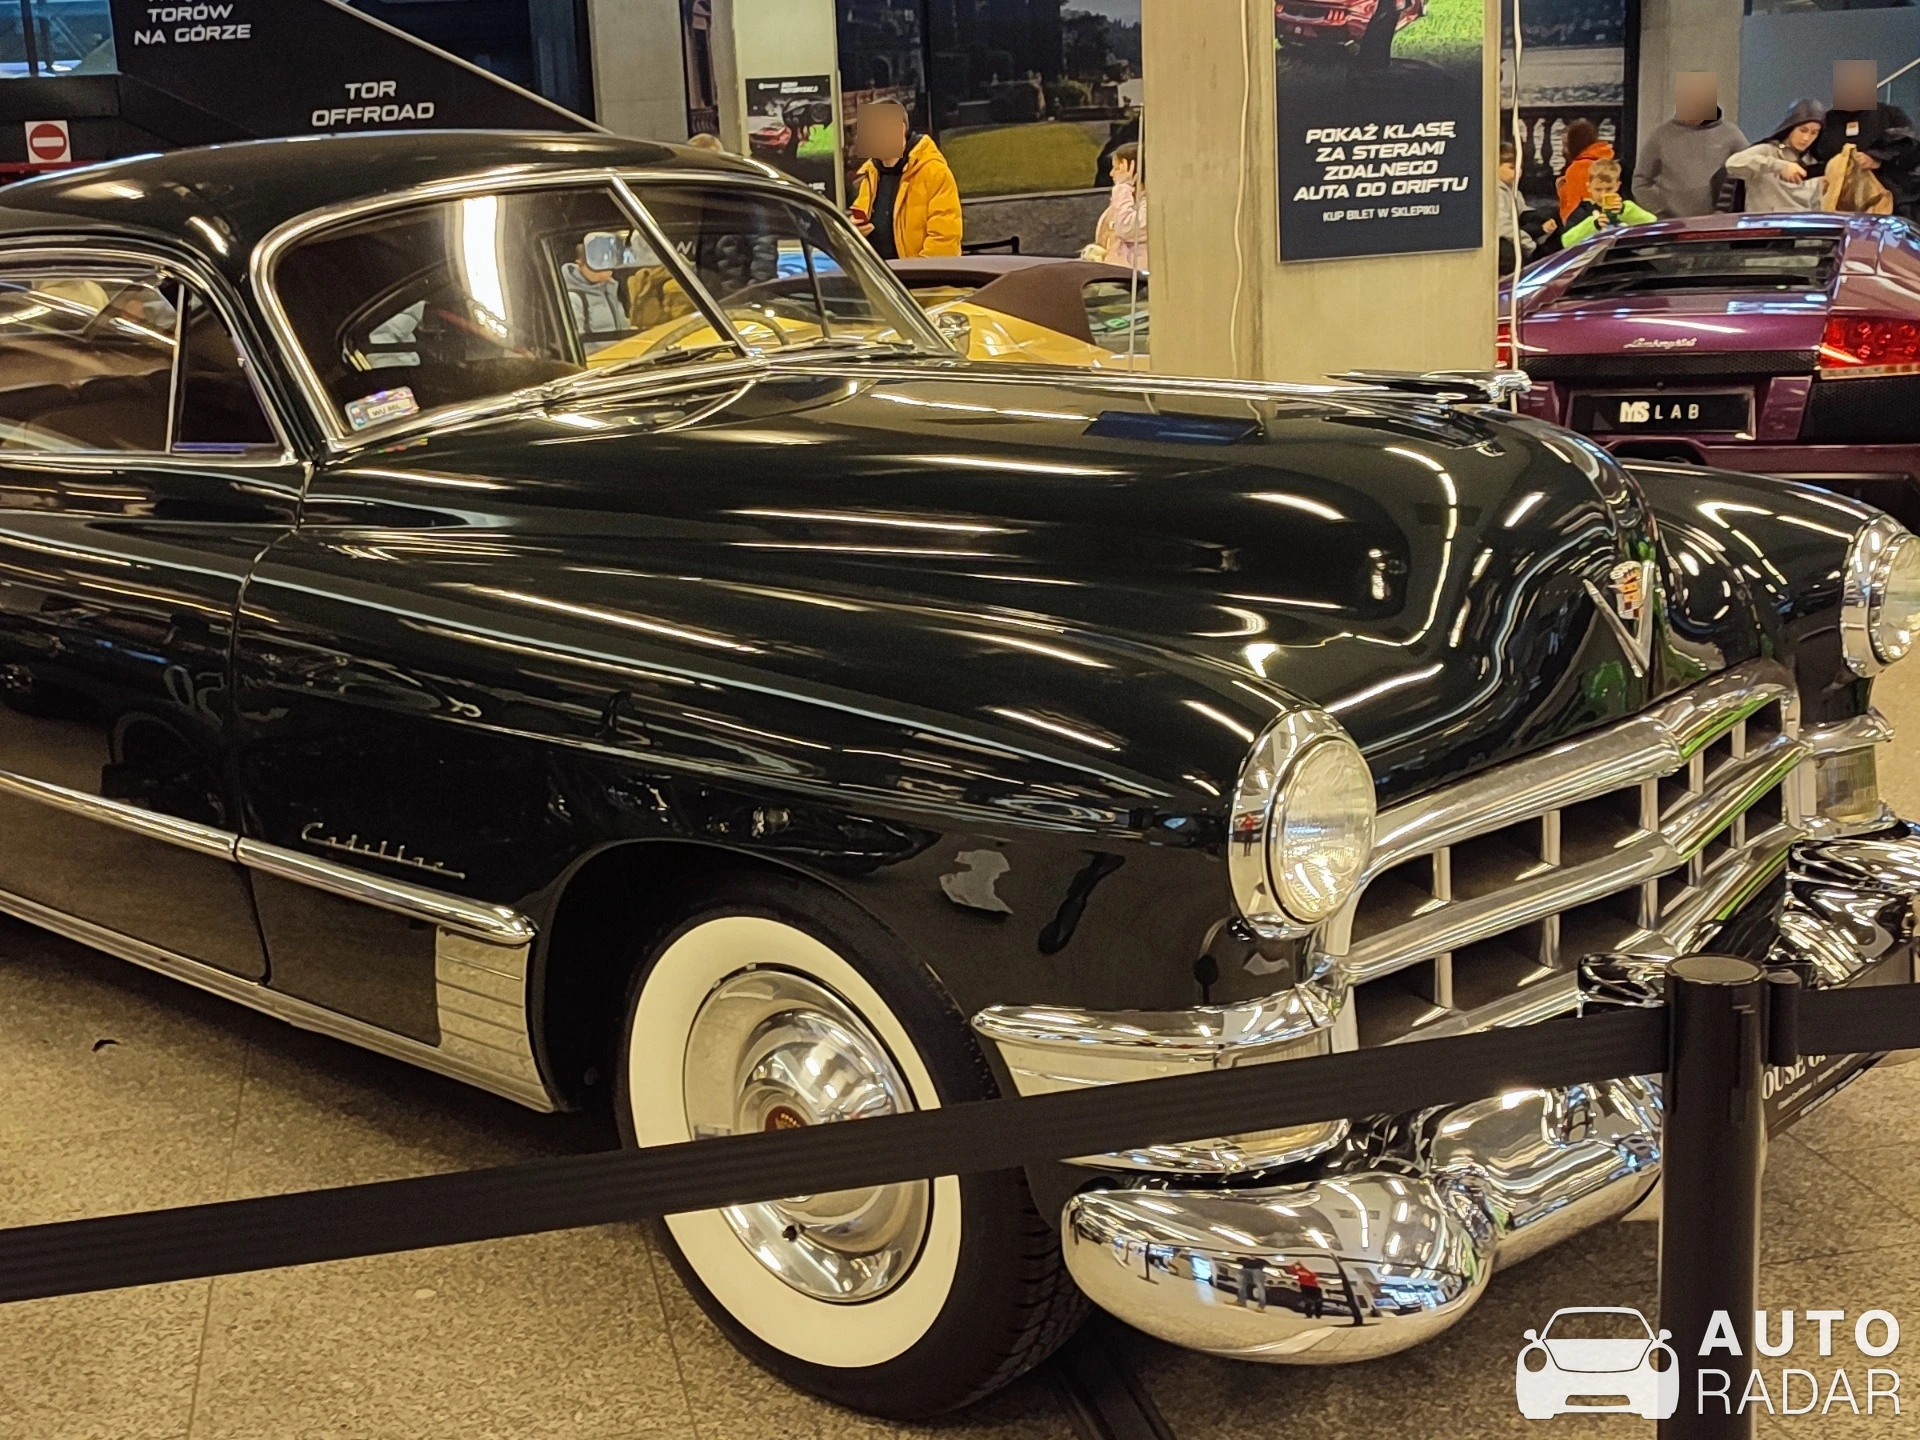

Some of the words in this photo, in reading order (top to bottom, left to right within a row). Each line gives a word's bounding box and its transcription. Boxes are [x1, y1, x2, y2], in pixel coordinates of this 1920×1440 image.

[147, 2, 234, 23] TORÓW
[134, 29, 166, 45] NA
[174, 24, 251, 42] GÓRZE
[344, 80, 397, 100] TOR
[311, 102, 435, 127] OFFROAD
[1305, 123, 1379, 144] POKAŻ
[1383, 121, 1457, 139] KLASĘ
[1315, 146, 1346, 162] ZA
[1351, 141, 1446, 160] STERAMI
[1323, 160, 1439, 181] ZDALNEGO
[1293, 185, 1350, 201] AUTA
[1355, 182, 1386, 198] DO
[1391, 176, 1469, 196] DRIFTU
[1322, 211, 1345, 222] KUP
[1346, 208, 1375, 221] BILET
[1377, 207, 1390, 218] W
[1391, 204, 1440, 217] SKLEPIKU
[1619, 401, 1651, 423] MS
[1654, 404, 1700, 420] LAB
[301, 821, 466, 880] Cadillac
[1761, 1054, 1806, 1100] OUSE
